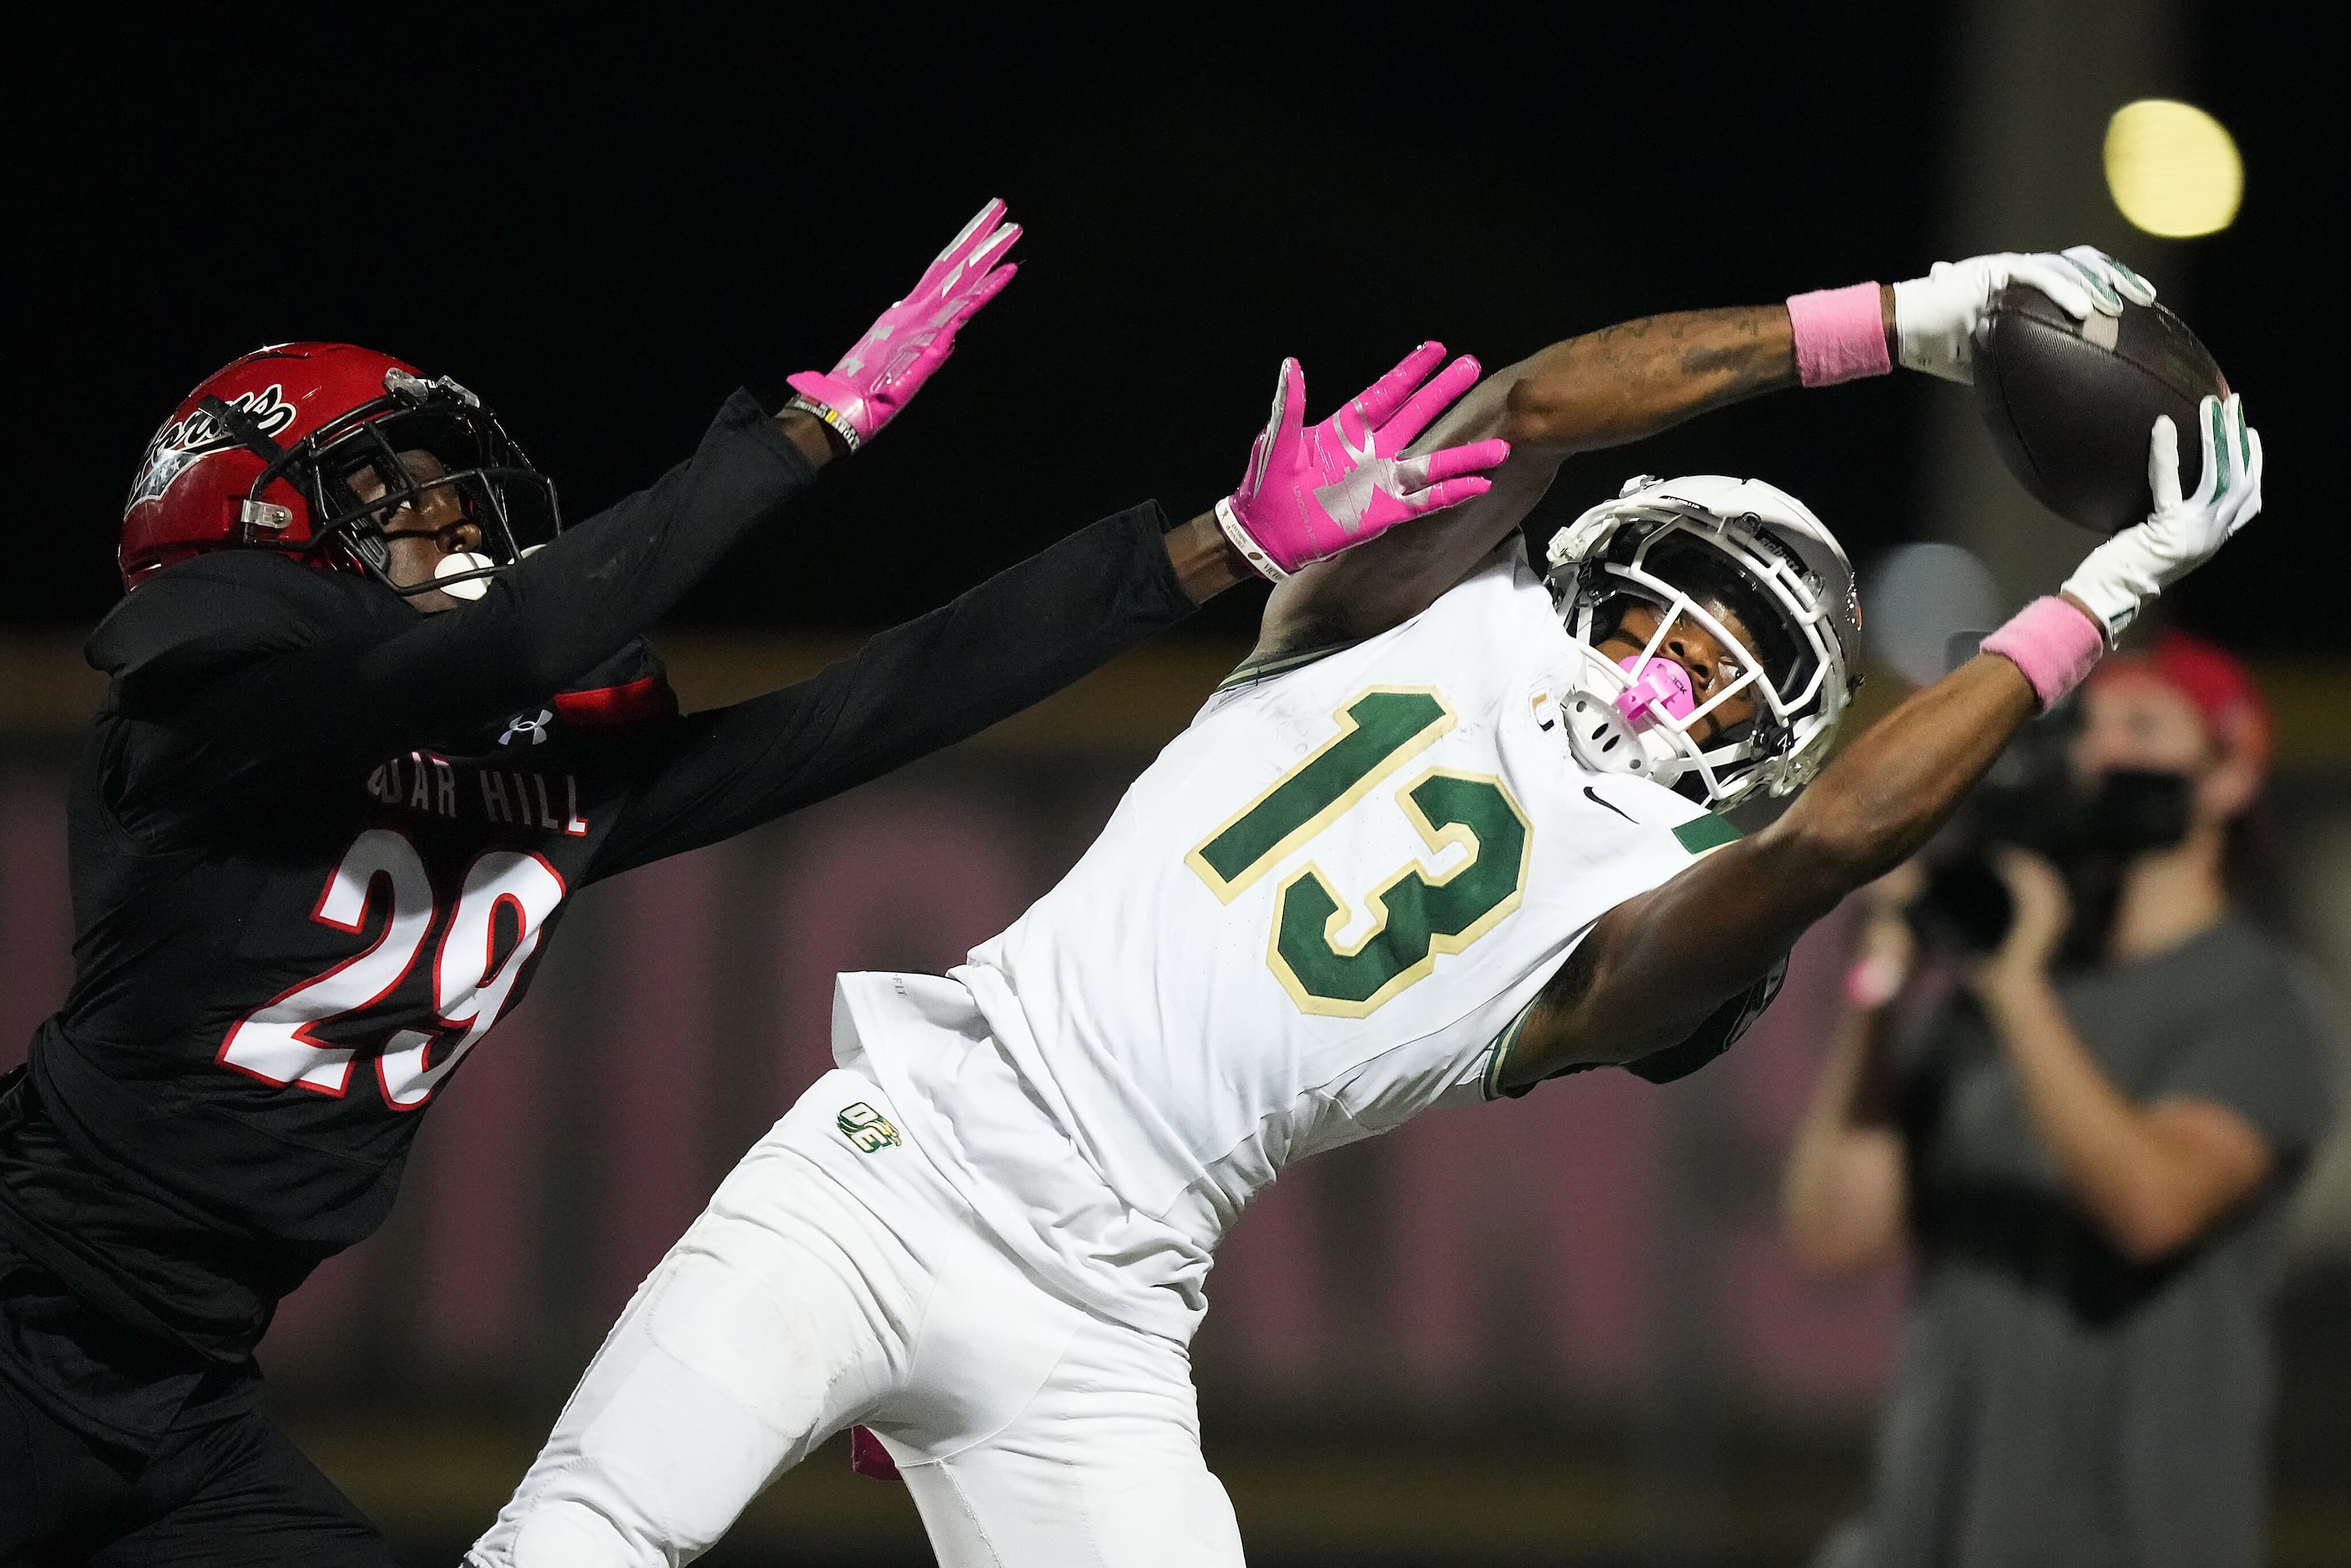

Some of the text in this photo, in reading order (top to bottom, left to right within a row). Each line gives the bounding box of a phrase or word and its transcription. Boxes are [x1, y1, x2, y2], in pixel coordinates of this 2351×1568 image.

[478, 768, 589, 837] HILL
[1183, 683, 1535, 1019] 13
[215, 827, 567, 1112] 29
